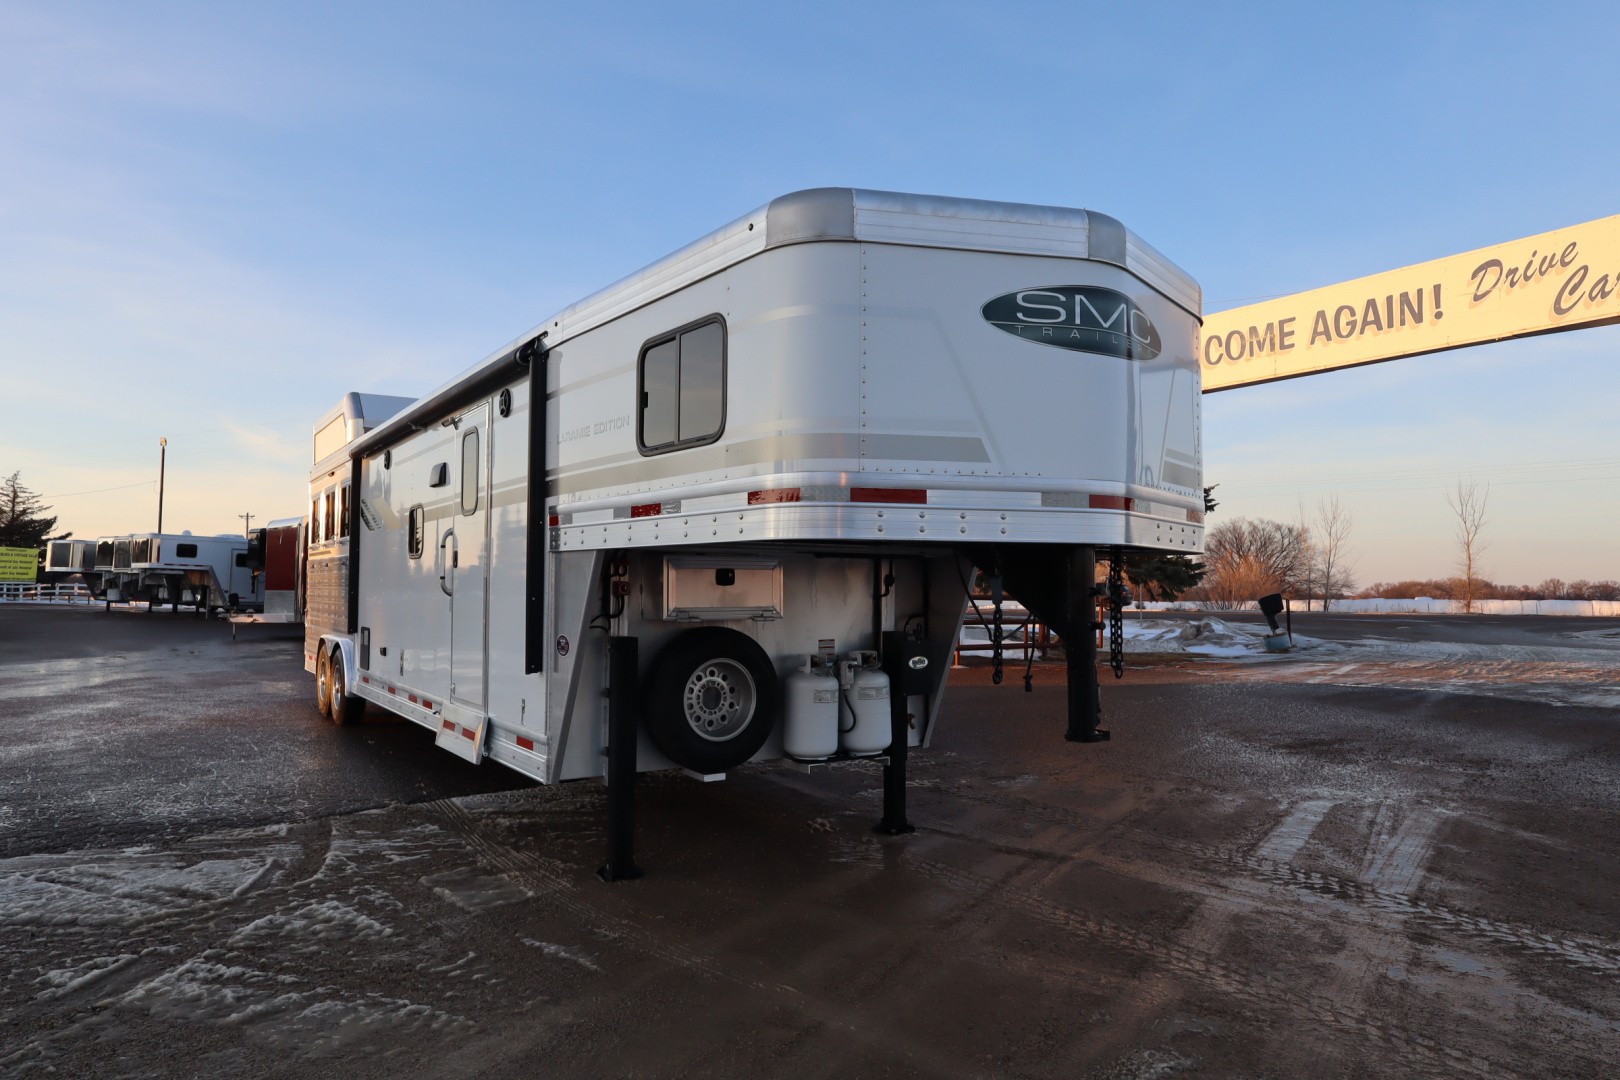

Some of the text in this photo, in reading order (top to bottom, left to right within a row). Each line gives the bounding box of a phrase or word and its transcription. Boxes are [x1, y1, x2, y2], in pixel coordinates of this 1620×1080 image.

[1470, 241, 1579, 303] Drive
[1014, 325, 1153, 359] TRAILERS
[1016, 291, 1151, 344] SMC
[1204, 283, 1445, 366] COME AGAIN!
[593, 414, 630, 435] EDITION
